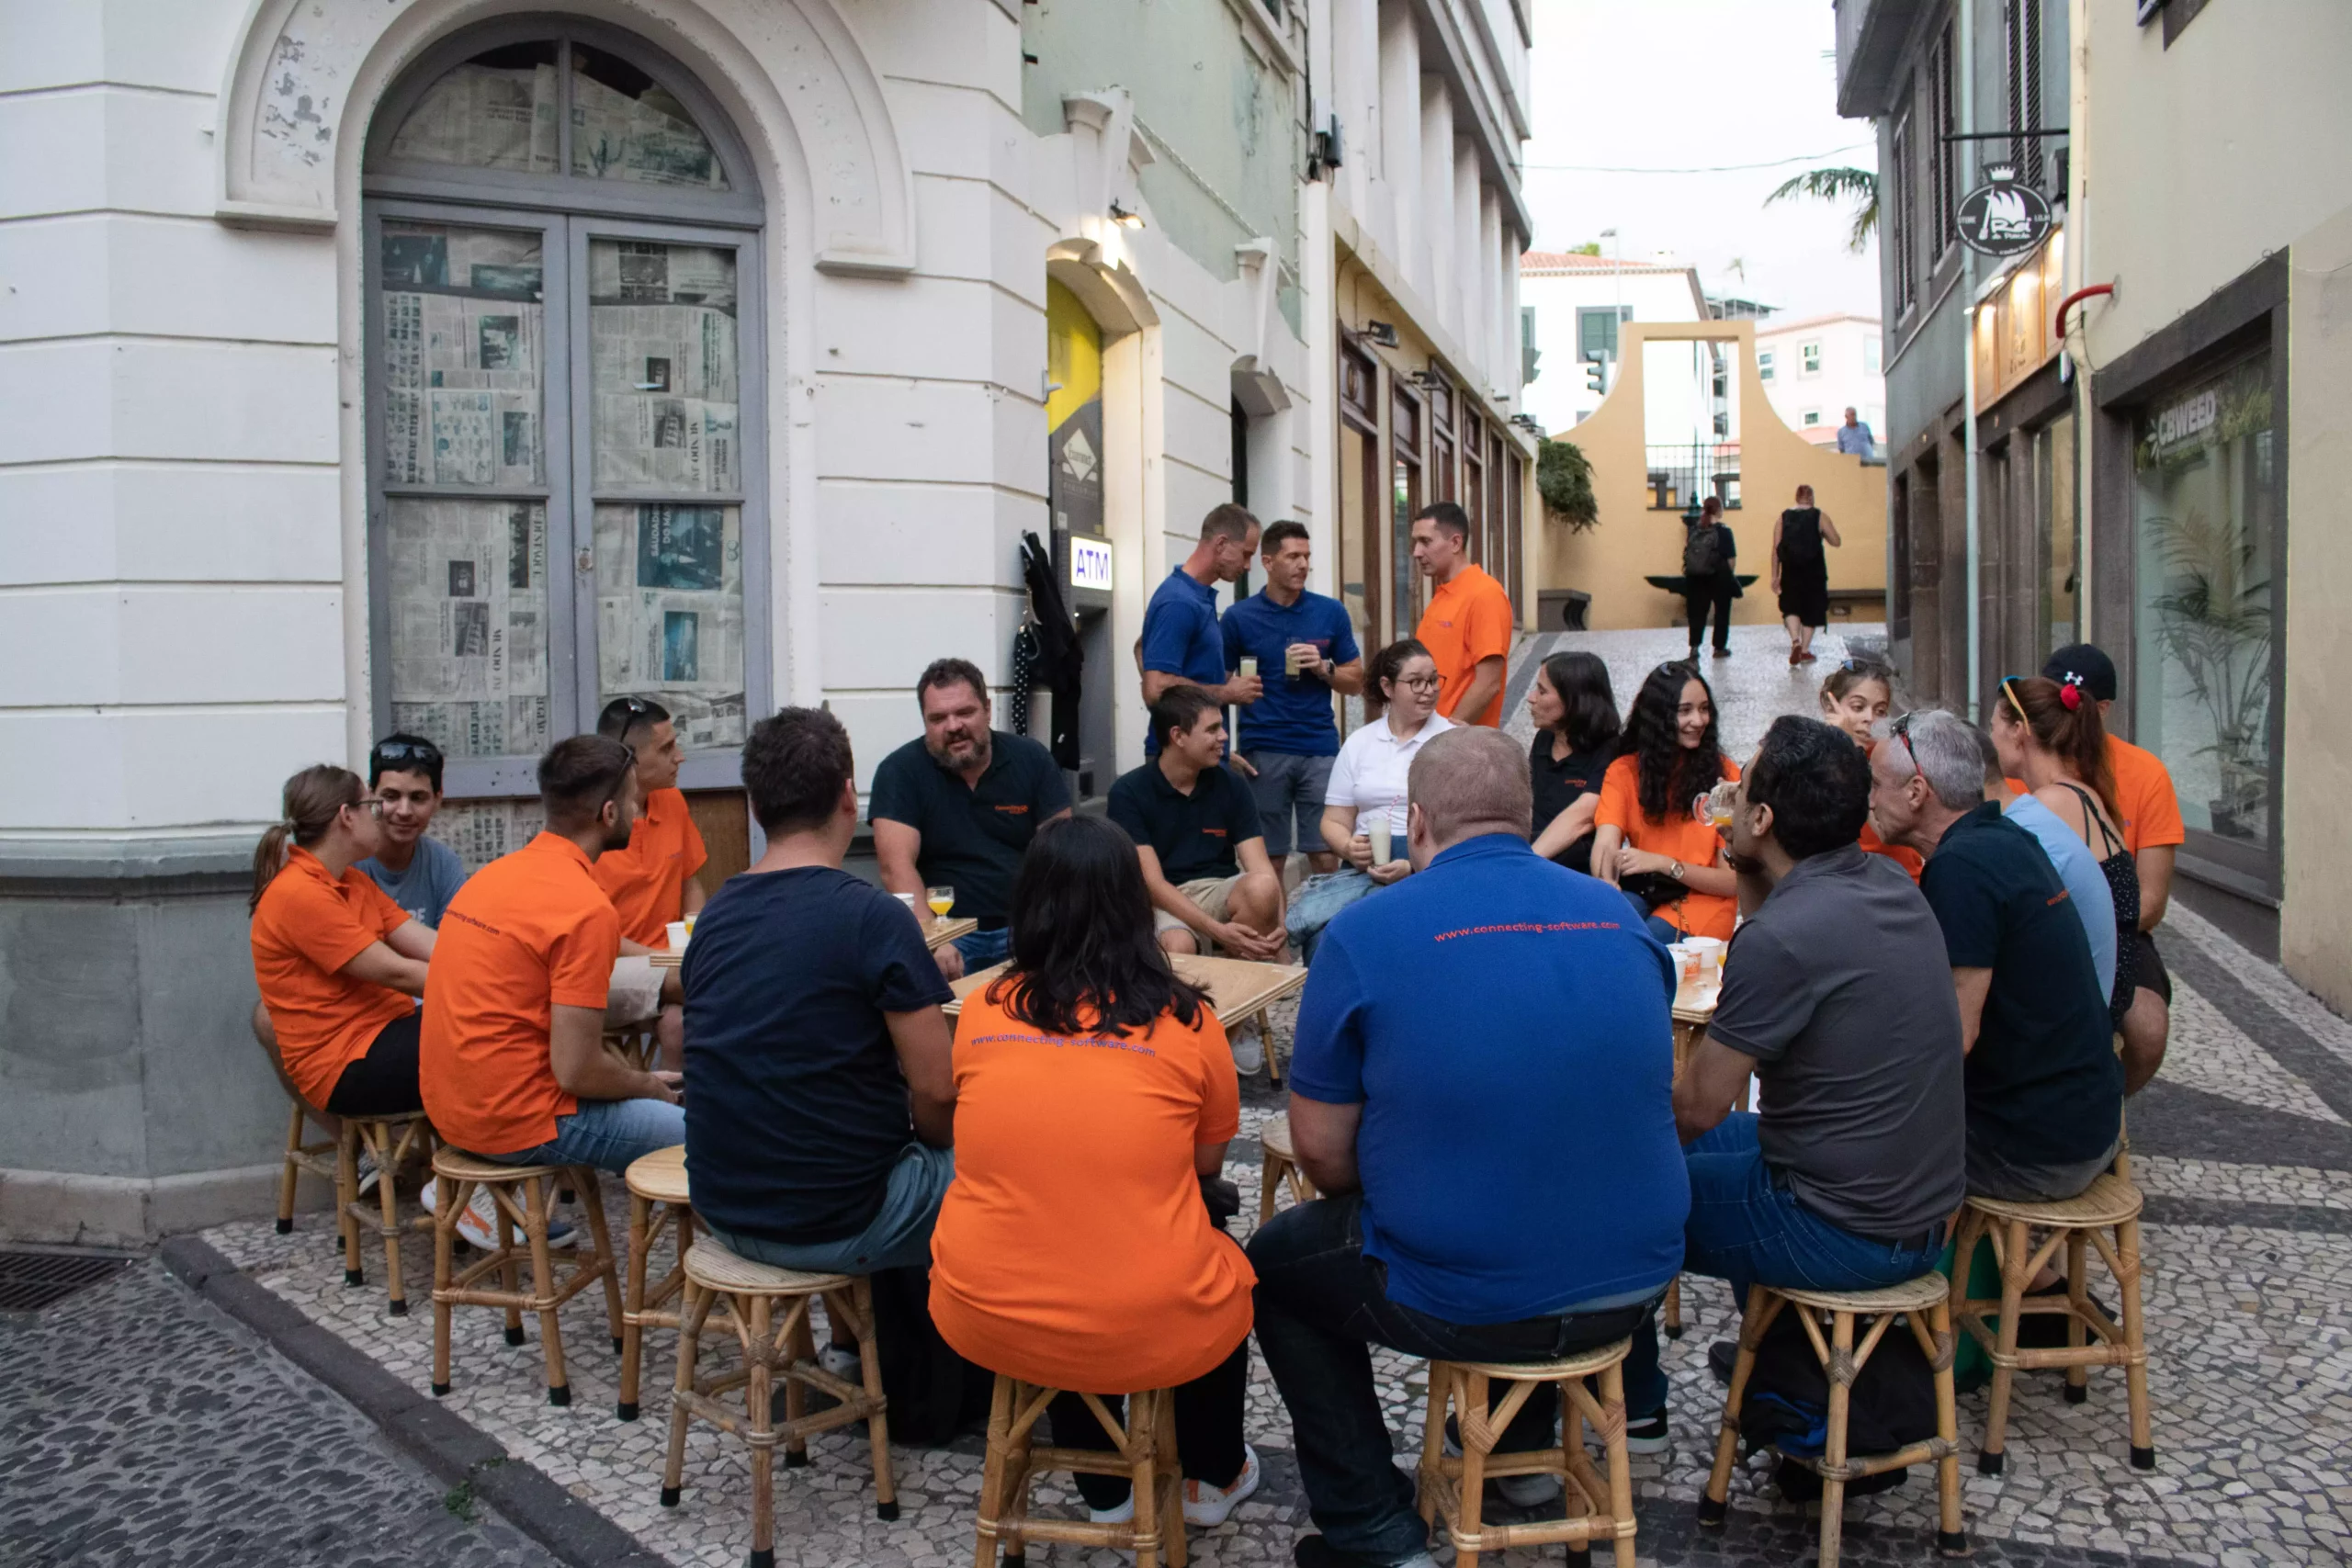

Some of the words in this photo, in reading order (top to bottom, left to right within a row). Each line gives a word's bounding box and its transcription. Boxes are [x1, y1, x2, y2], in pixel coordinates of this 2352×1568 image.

[2158, 389, 2217, 446] CBWEED
[1076, 548, 1108, 581] ATM
[1434, 921, 1621, 942] www.connecting-software.com
[970, 1032, 1156, 1057] www.connecting-software.com
